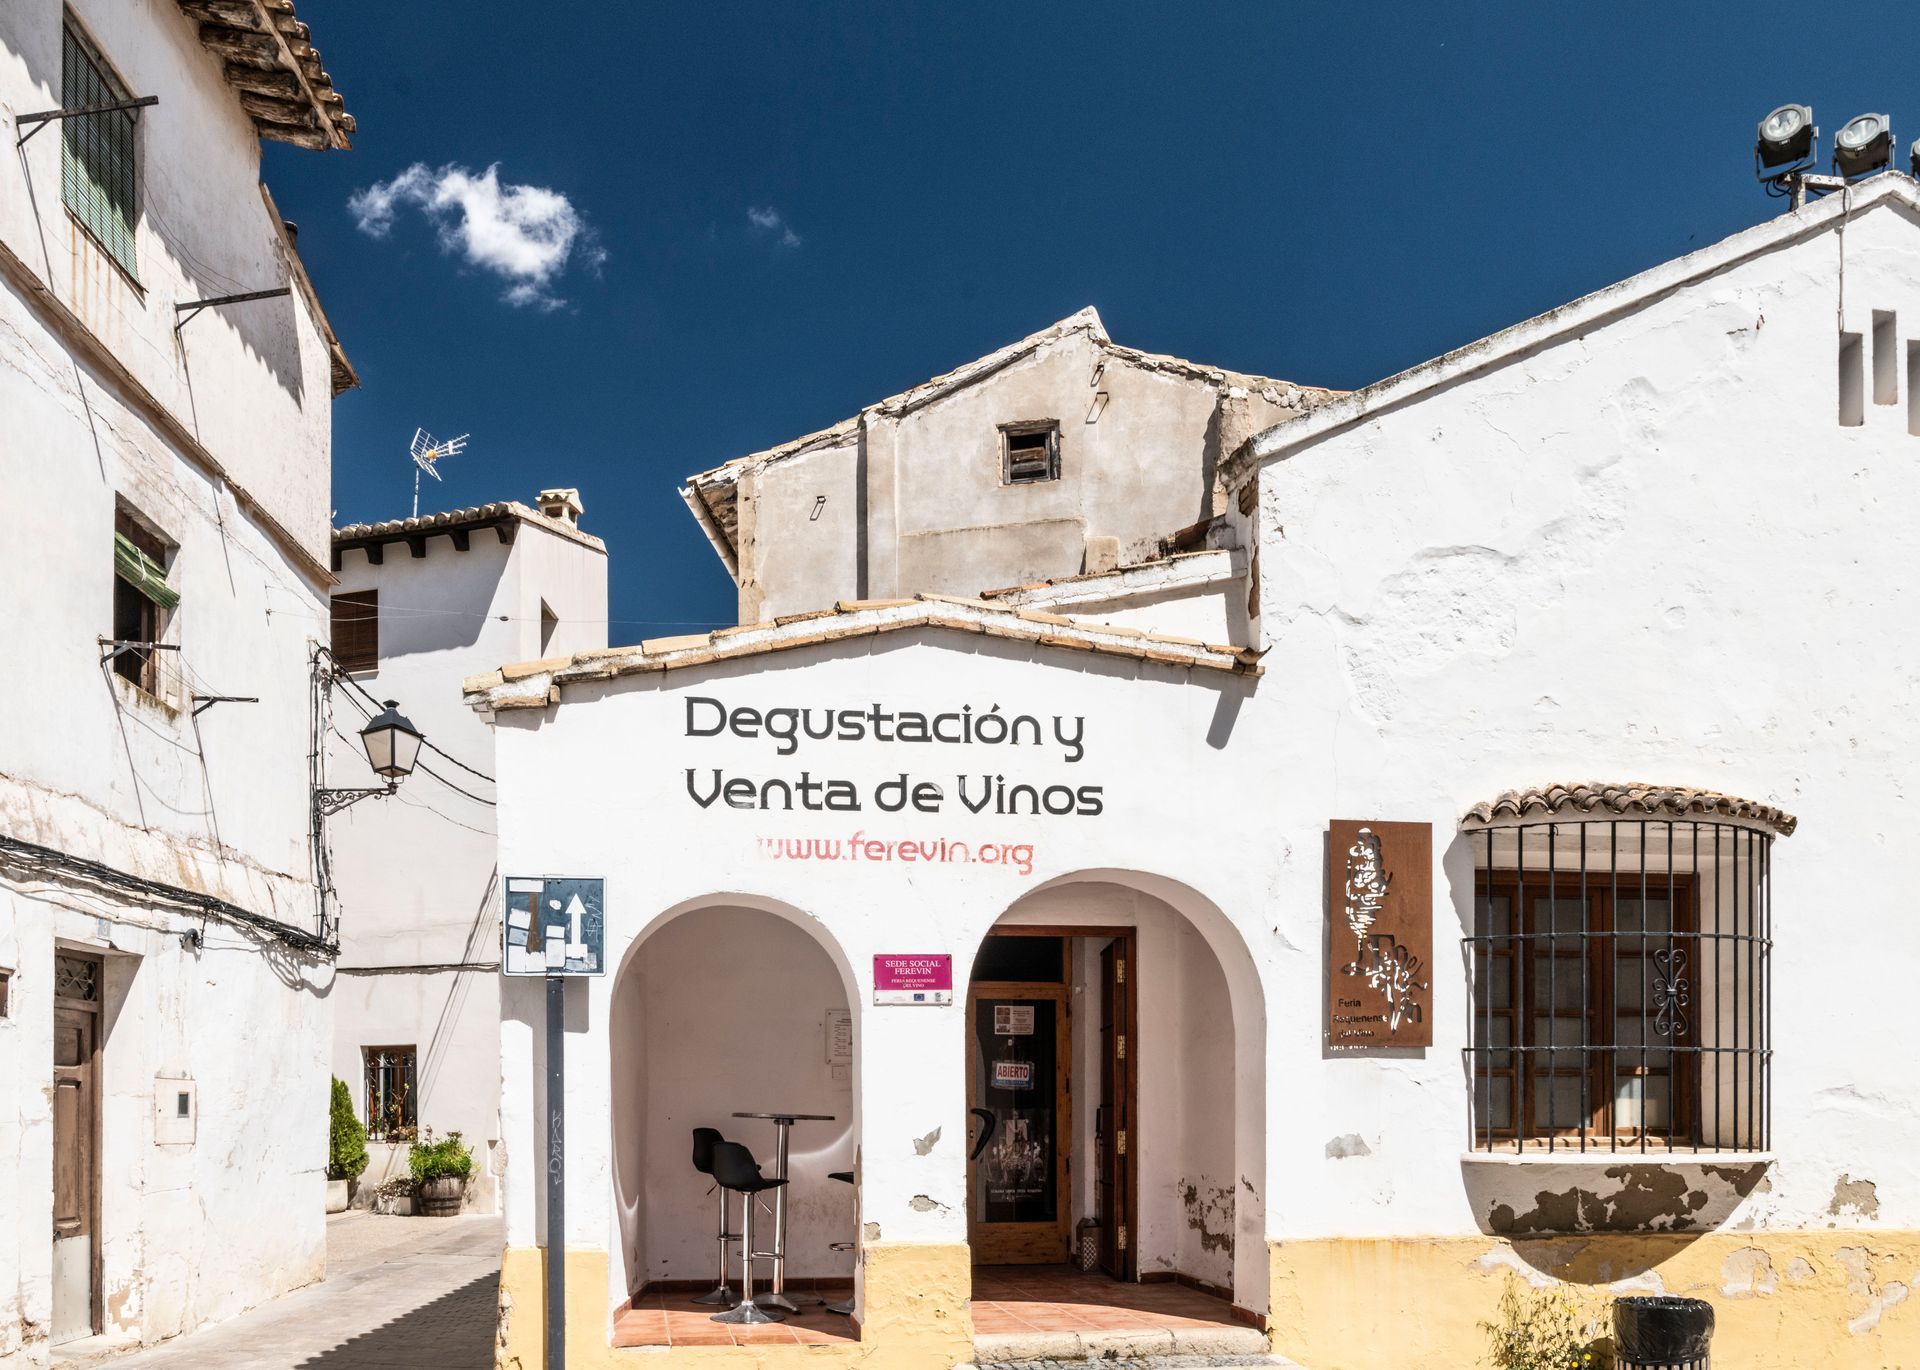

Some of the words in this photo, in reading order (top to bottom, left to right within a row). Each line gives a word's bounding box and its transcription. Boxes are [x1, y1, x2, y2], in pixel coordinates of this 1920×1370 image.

[684, 695, 1042, 756] Degustación
[1052, 715, 1086, 763] y
[684, 768, 862, 811] Venta
[874, 773, 944, 813] de
[958, 774, 1104, 816] Vinos
[885, 960, 908, 968] SEDE
[909, 960, 941, 968] SOCIAL
[997, 1065, 1029, 1078] ABIERTO
